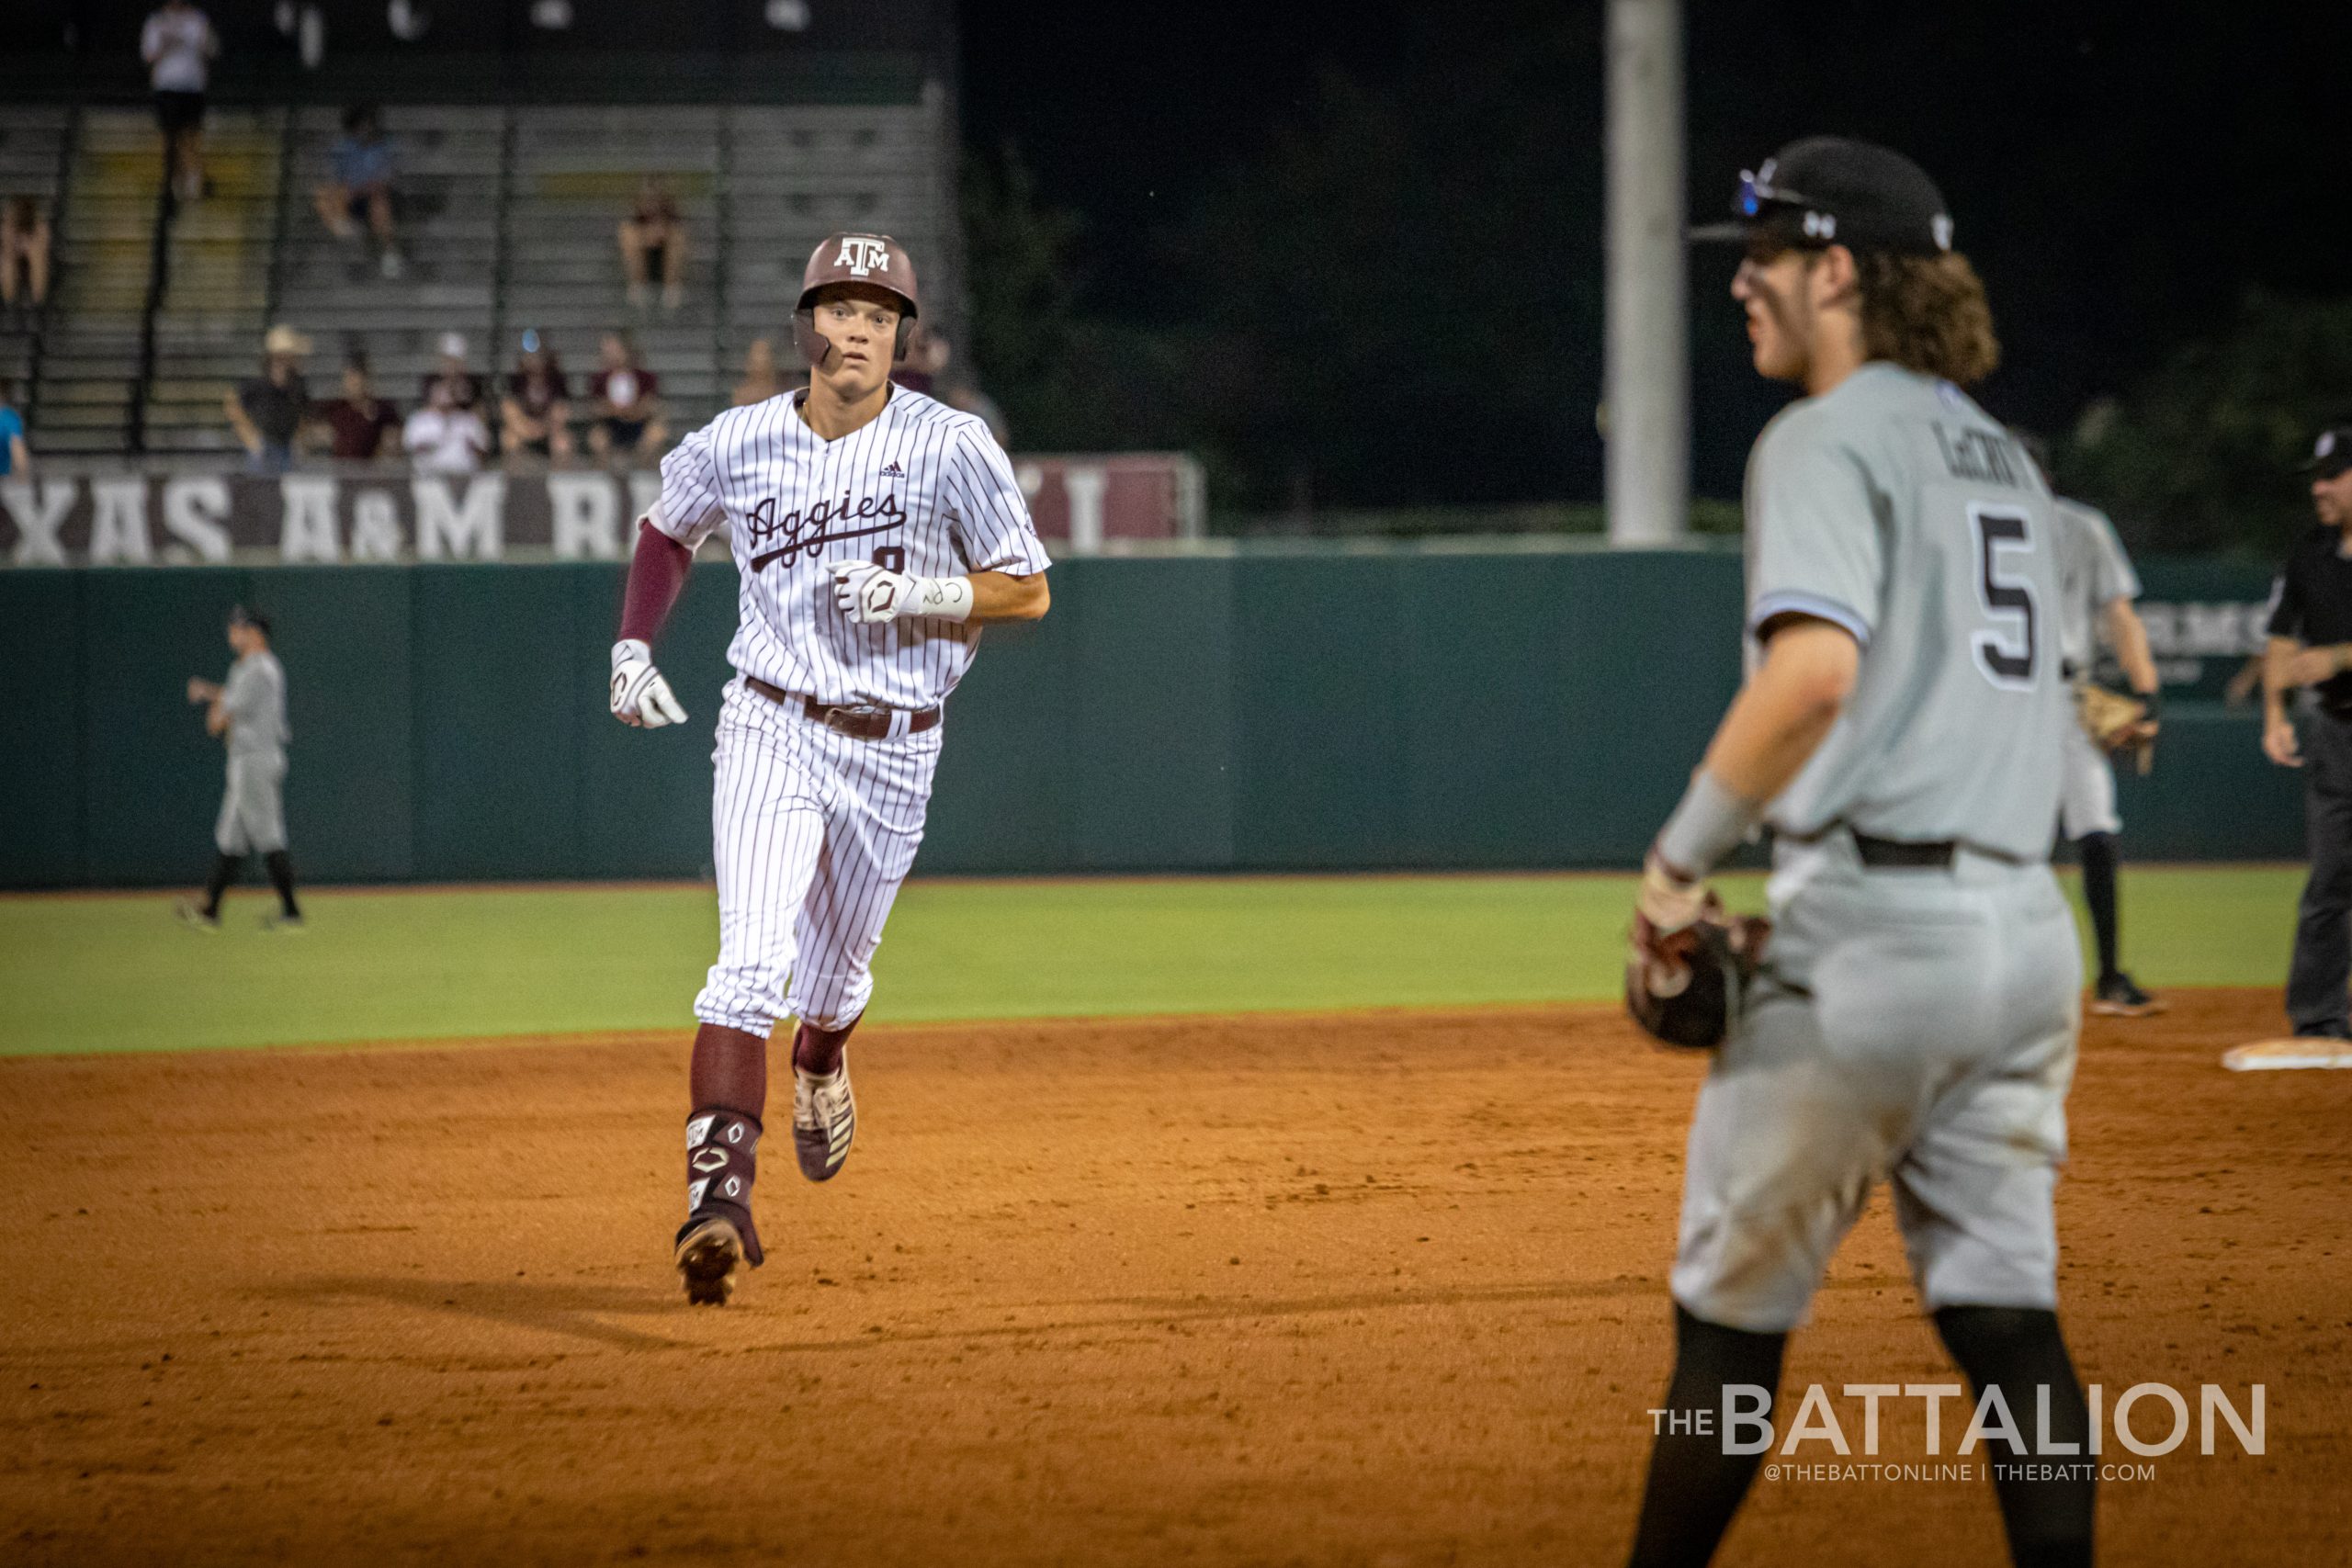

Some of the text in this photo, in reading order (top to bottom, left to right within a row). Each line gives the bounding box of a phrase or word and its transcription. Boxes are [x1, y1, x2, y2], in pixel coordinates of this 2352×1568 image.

[278, 474, 505, 564] A&M
[746, 490, 907, 571] Aggies
[1967, 502, 2040, 693] 5
